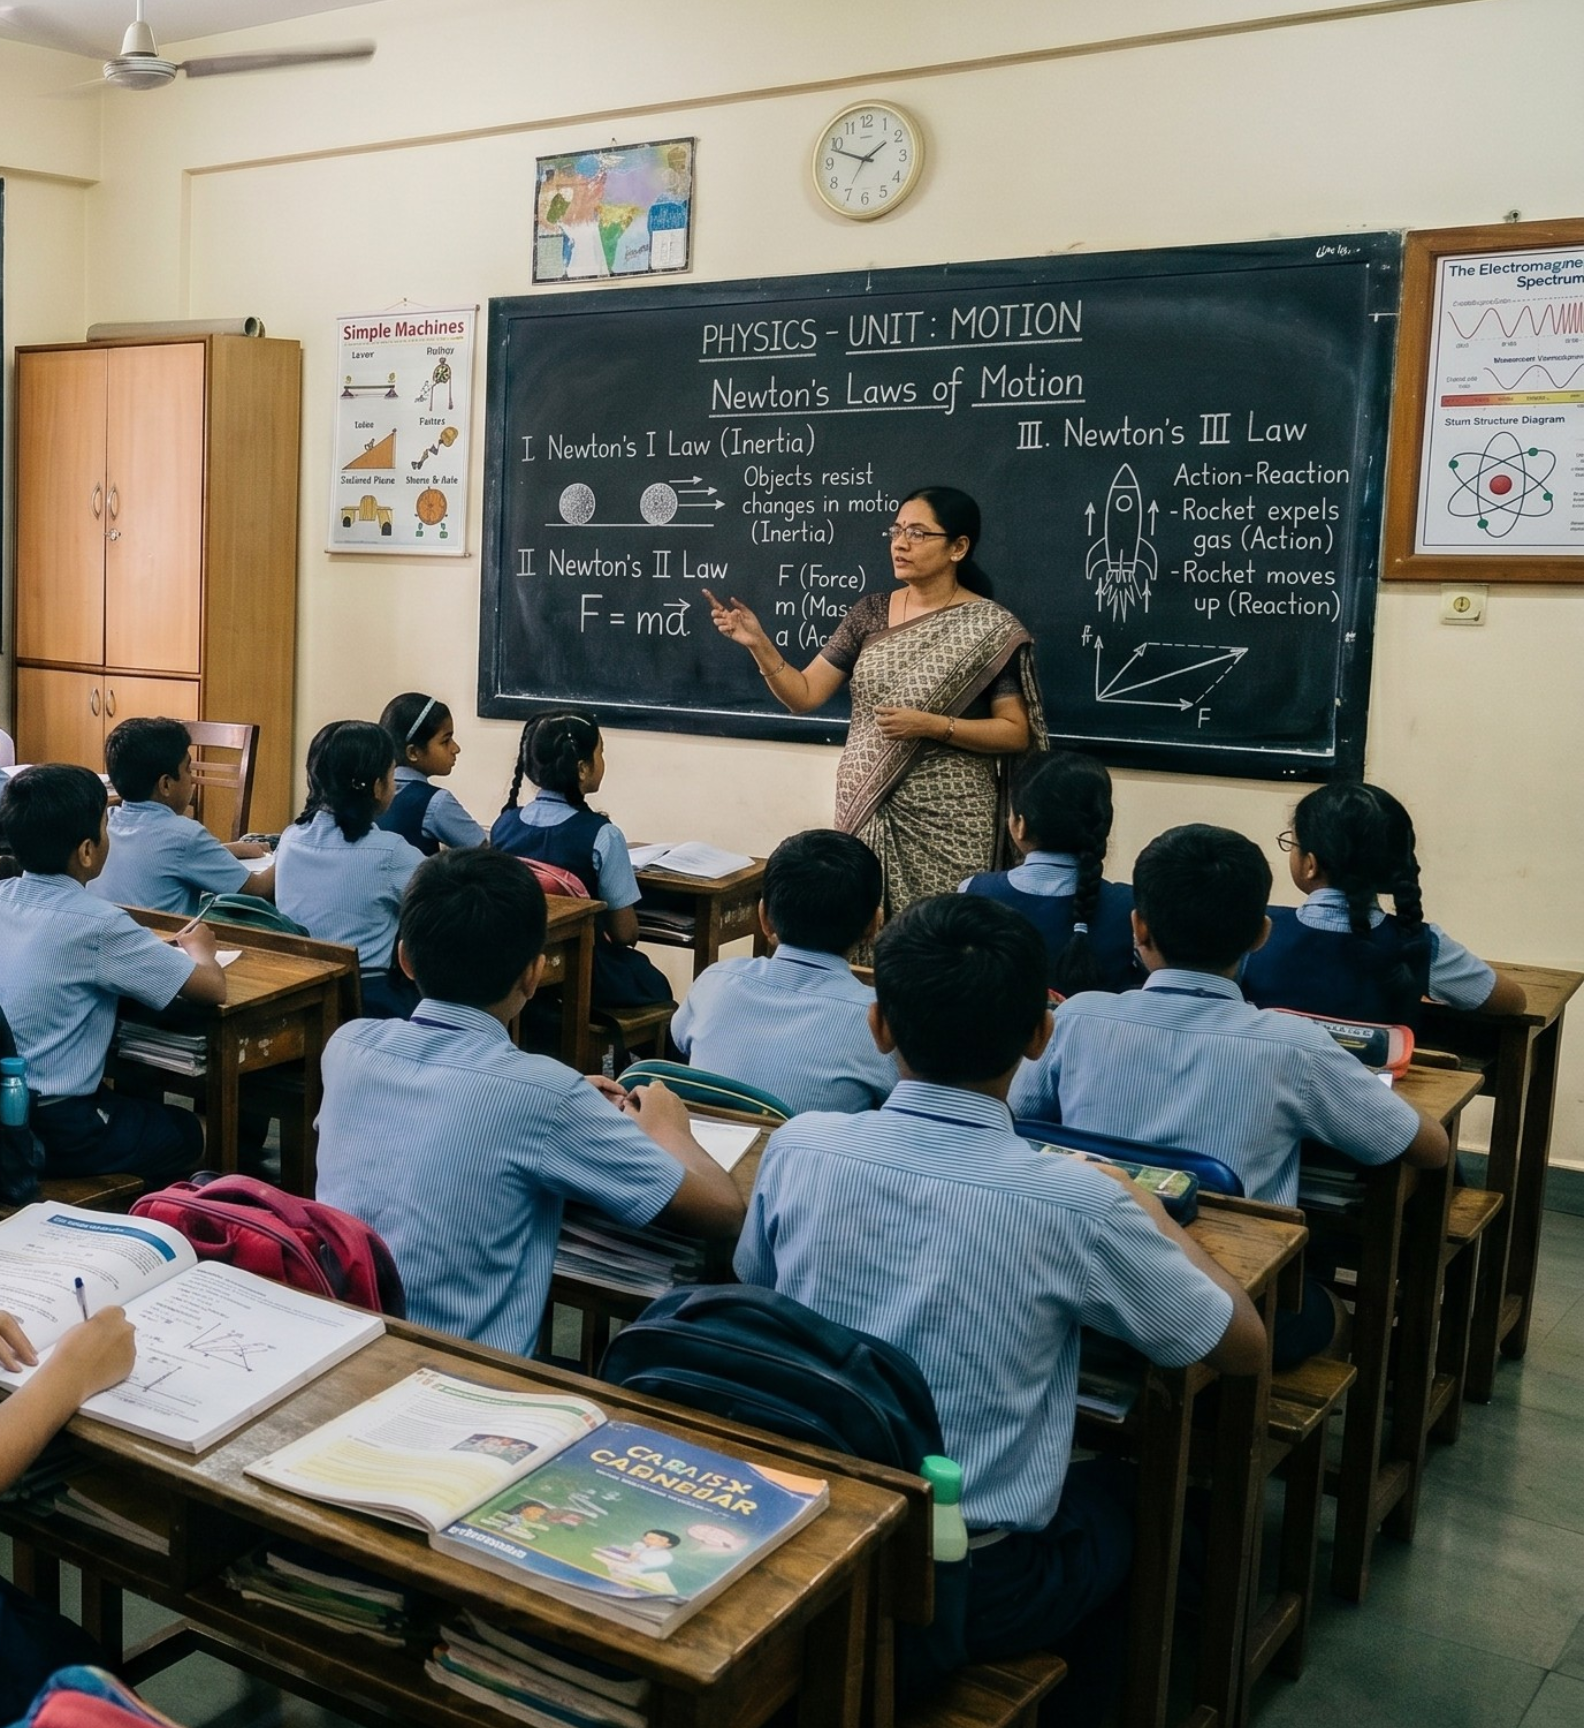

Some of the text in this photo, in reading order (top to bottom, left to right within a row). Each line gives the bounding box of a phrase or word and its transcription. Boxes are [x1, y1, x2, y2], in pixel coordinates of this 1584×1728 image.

[845, 121, 855, 135] 11
[860, 114, 873, 128] 12
[882, 117, 887, 131] 1
[831, 136, 843, 150] 10
[894, 129, 903, 143] 2
[825, 157, 834, 170] 9
[898, 149, 907, 162] 3
[829, 176, 838, 189] 8
[892, 170, 901, 183] 4
[844, 188, 853, 201] 7
[860, 191, 869, 205] 6
[879, 185, 888, 198] 5
[1449, 264, 1476, 277] The
[1516, 274, 1584, 290] Spectrum
[343, 322, 391, 342] Simple
[395, 319, 464, 337] Machines
[702, 318, 817, 354] PHYSICS
[951, 300, 1083, 341] MOTION
[712, 363, 1084, 415] Newton's Laws of Motion
[1064, 415, 1185, 447] Newton's
[1199, 412, 1232, 445] III
[1247, 410, 1308, 442] Law
[1473, 416, 1519, 426] Structure
[1522, 415, 1566, 426] Diagram
[521, 423, 815, 463] I Newton's I Law (Inertia)
[744, 462, 874, 494] Objects resist
[1173, 460, 1349, 487] Action-Reaction
[742, 489, 900, 522] changes in motio
[1267, 496, 1340, 529] expels
[751, 519, 834, 545] (Inertia)
[1193, 524, 1333, 557] gas (Action)
[516, 548, 728, 579] II Newton's II Law
[778, 562, 866, 593] F (Force)
[1267, 570, 1336, 586] moves
[580, 593, 603, 633] F
[775, 591, 852, 621] m (Mas
[1194, 589, 1341, 623] up (Reaction)
[775, 629, 789, 647] a
[1197, 707, 1212, 729] F
